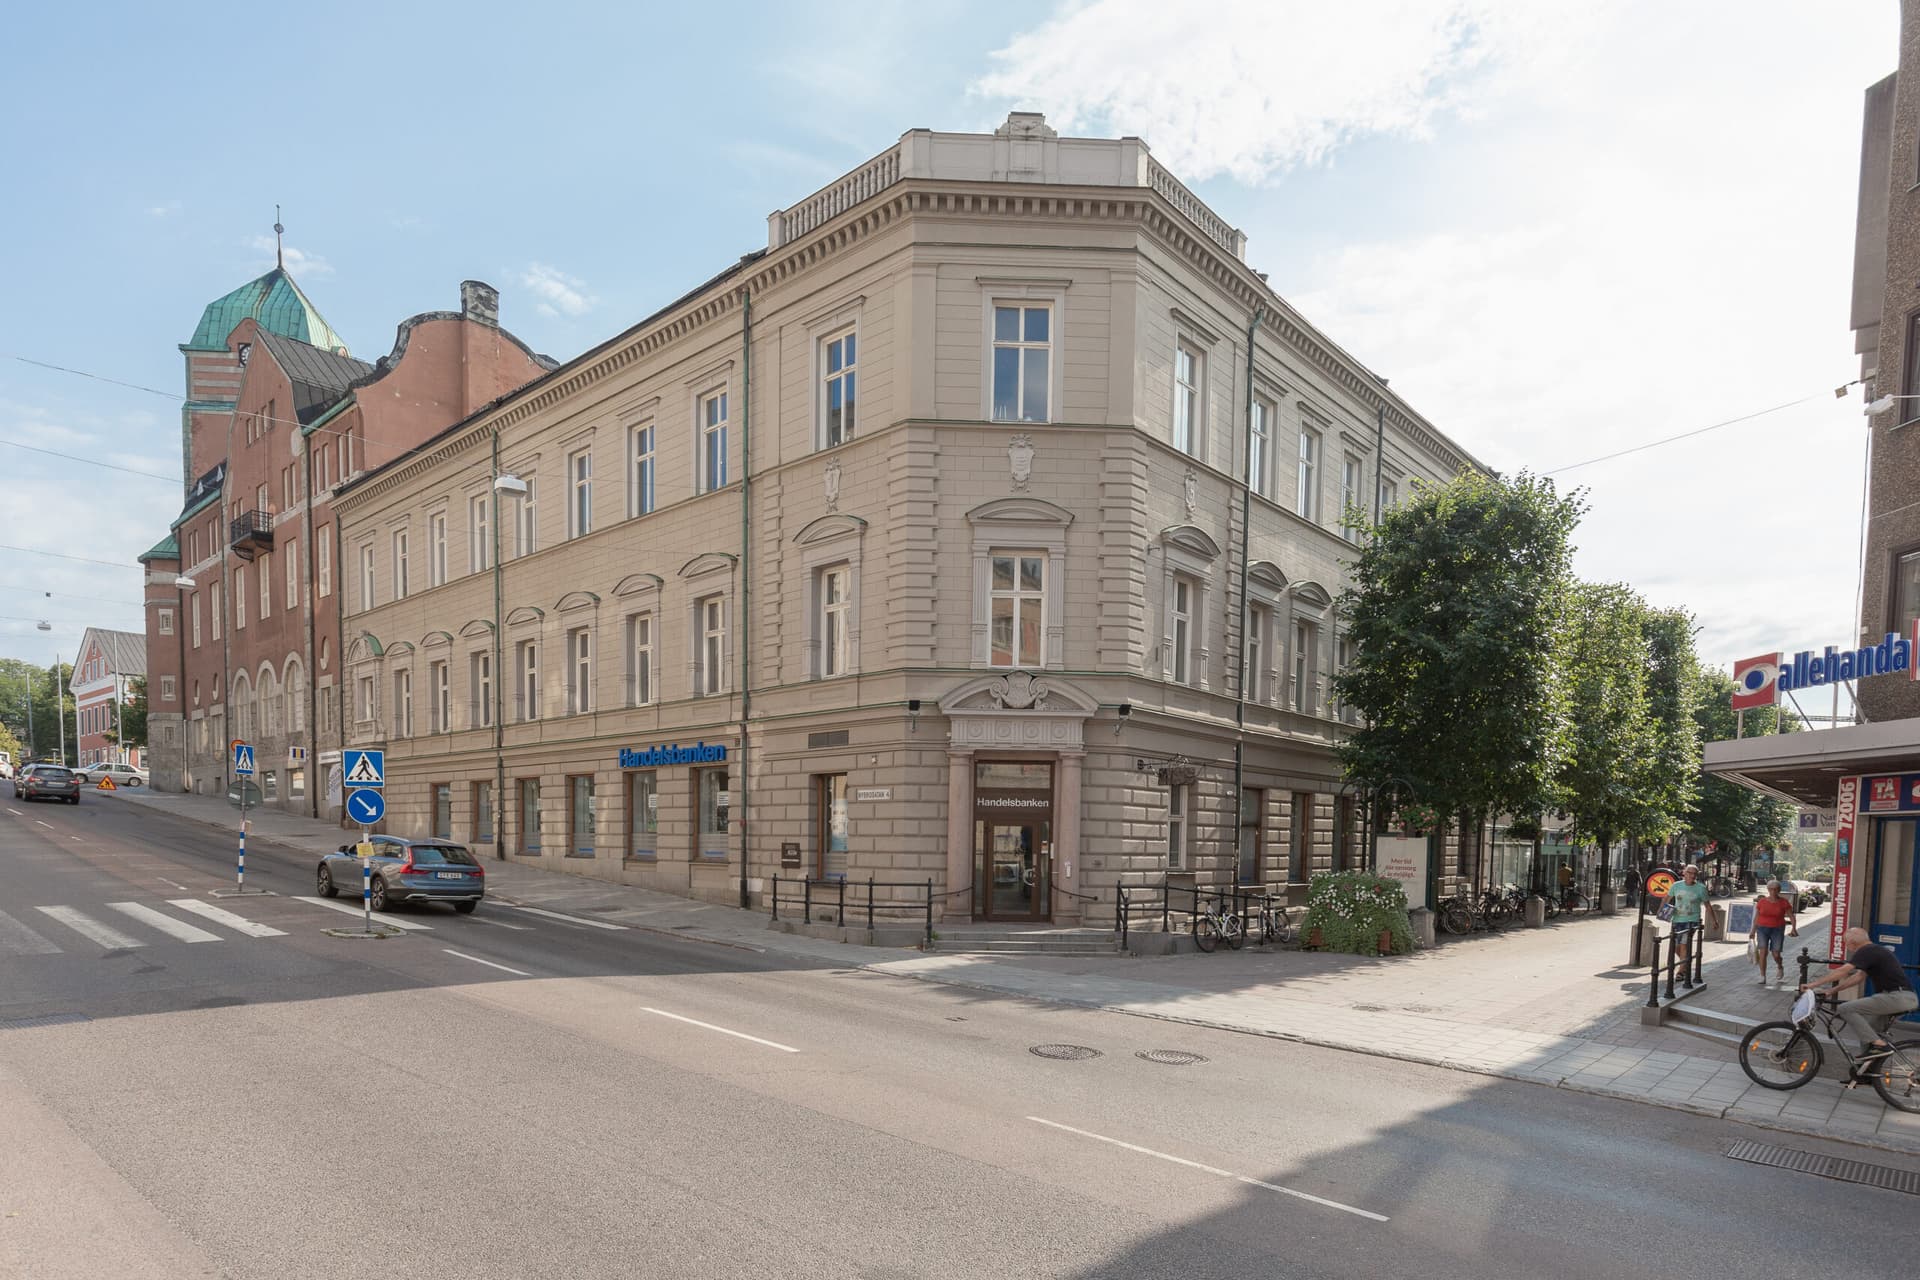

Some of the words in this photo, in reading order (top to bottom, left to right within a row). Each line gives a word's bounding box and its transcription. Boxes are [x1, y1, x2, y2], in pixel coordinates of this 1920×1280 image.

[1778, 632, 1911, 692] allehanda
[619, 741, 727, 768] Handelsbanken
[1874, 777, 1897, 800] TÅ
[977, 798, 1049, 808] Handelsbanken
[1838, 781, 1856, 830] 72006
[1835, 873, 1848, 915] nyheter
[1835, 916, 1844, 934] om
